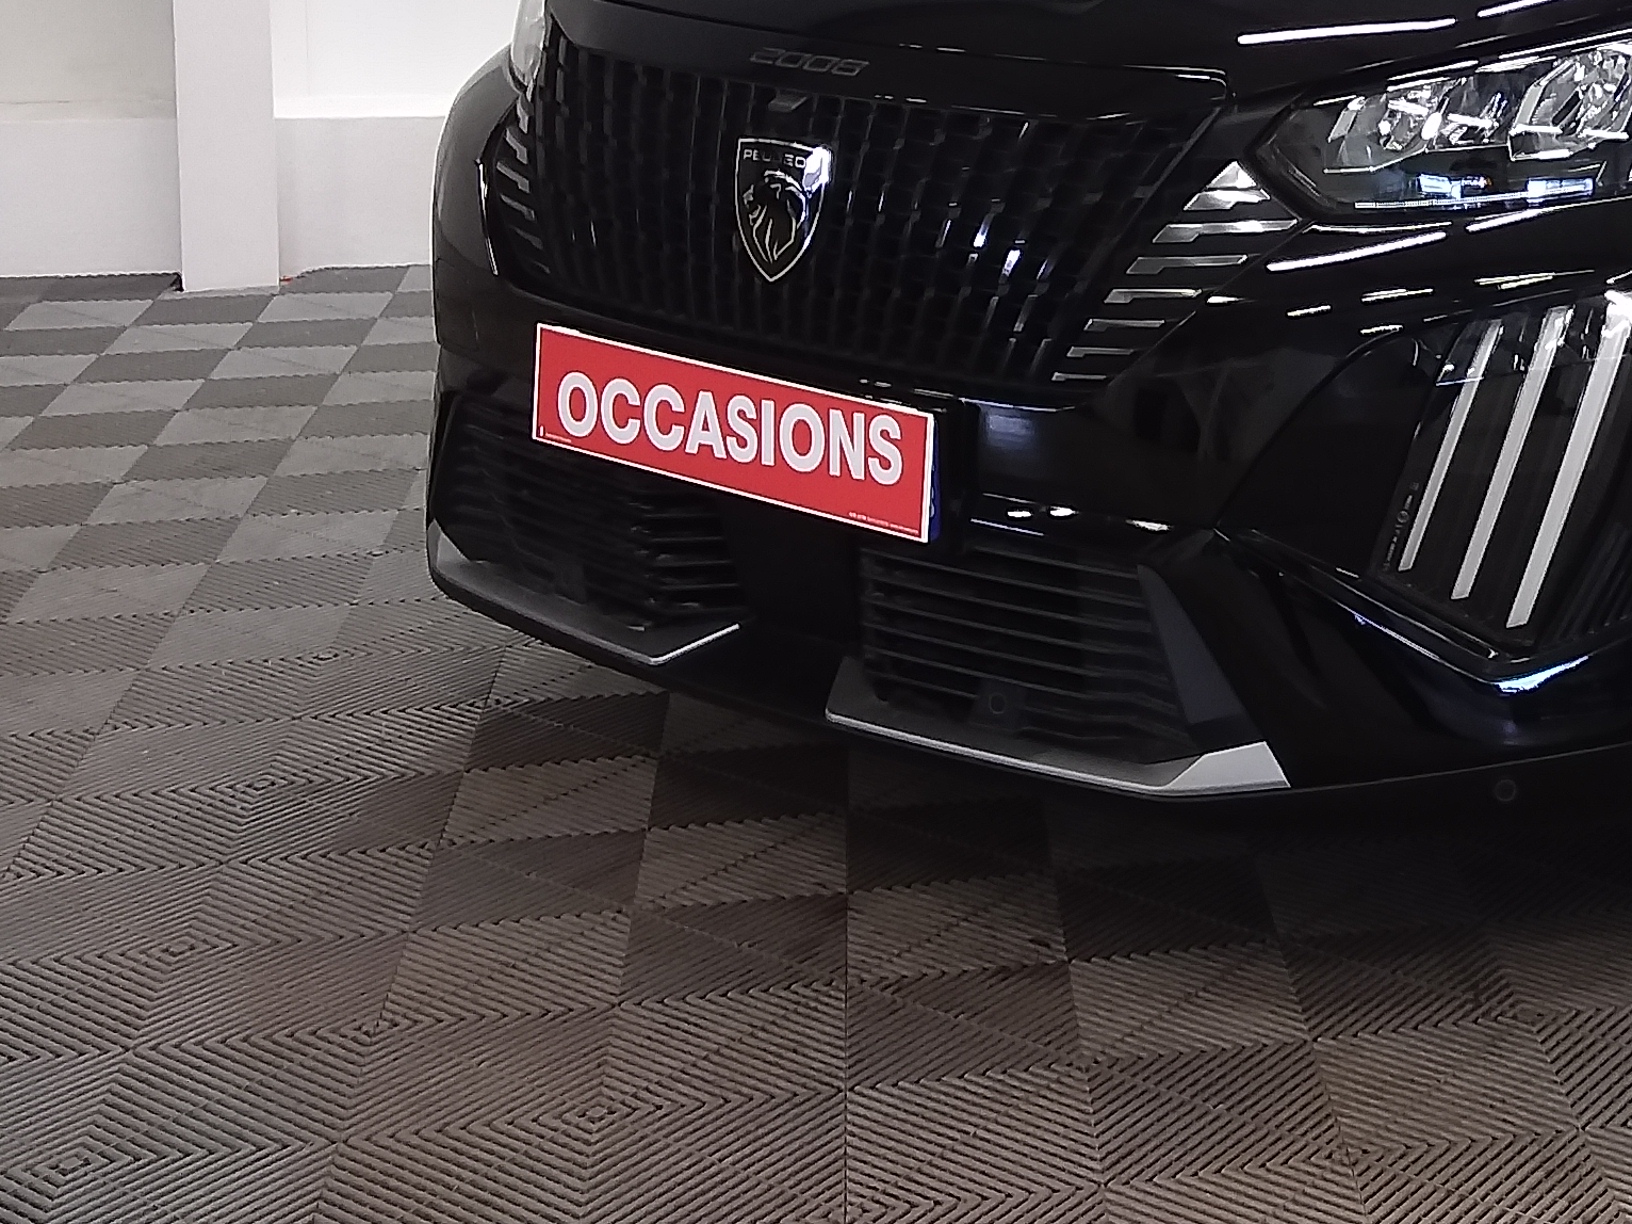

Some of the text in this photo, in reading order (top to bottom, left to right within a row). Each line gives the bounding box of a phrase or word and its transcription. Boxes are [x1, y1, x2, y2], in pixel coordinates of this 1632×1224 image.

[750, 47, 870, 76] 2008
[743, 148, 813, 171] PEUEO
[557, 371, 902, 485] OCCASIONS
